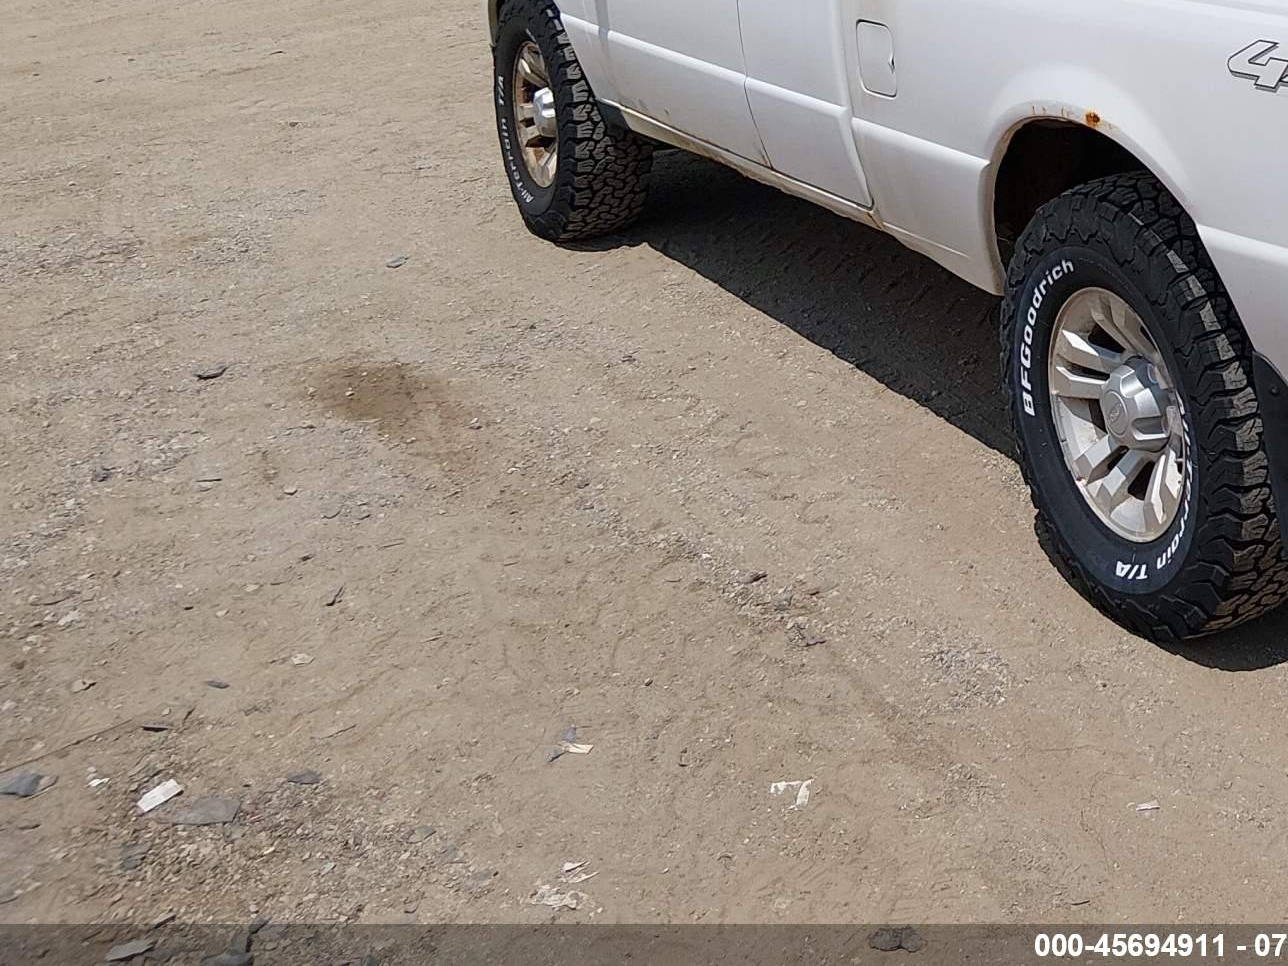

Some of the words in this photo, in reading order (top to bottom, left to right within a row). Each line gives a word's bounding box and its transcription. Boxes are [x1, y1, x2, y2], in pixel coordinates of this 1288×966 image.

[497, 75, 505, 106] T/A
[1020, 258, 1075, 417] BFGoodrich
[1115, 560, 1148, 580] T/A
